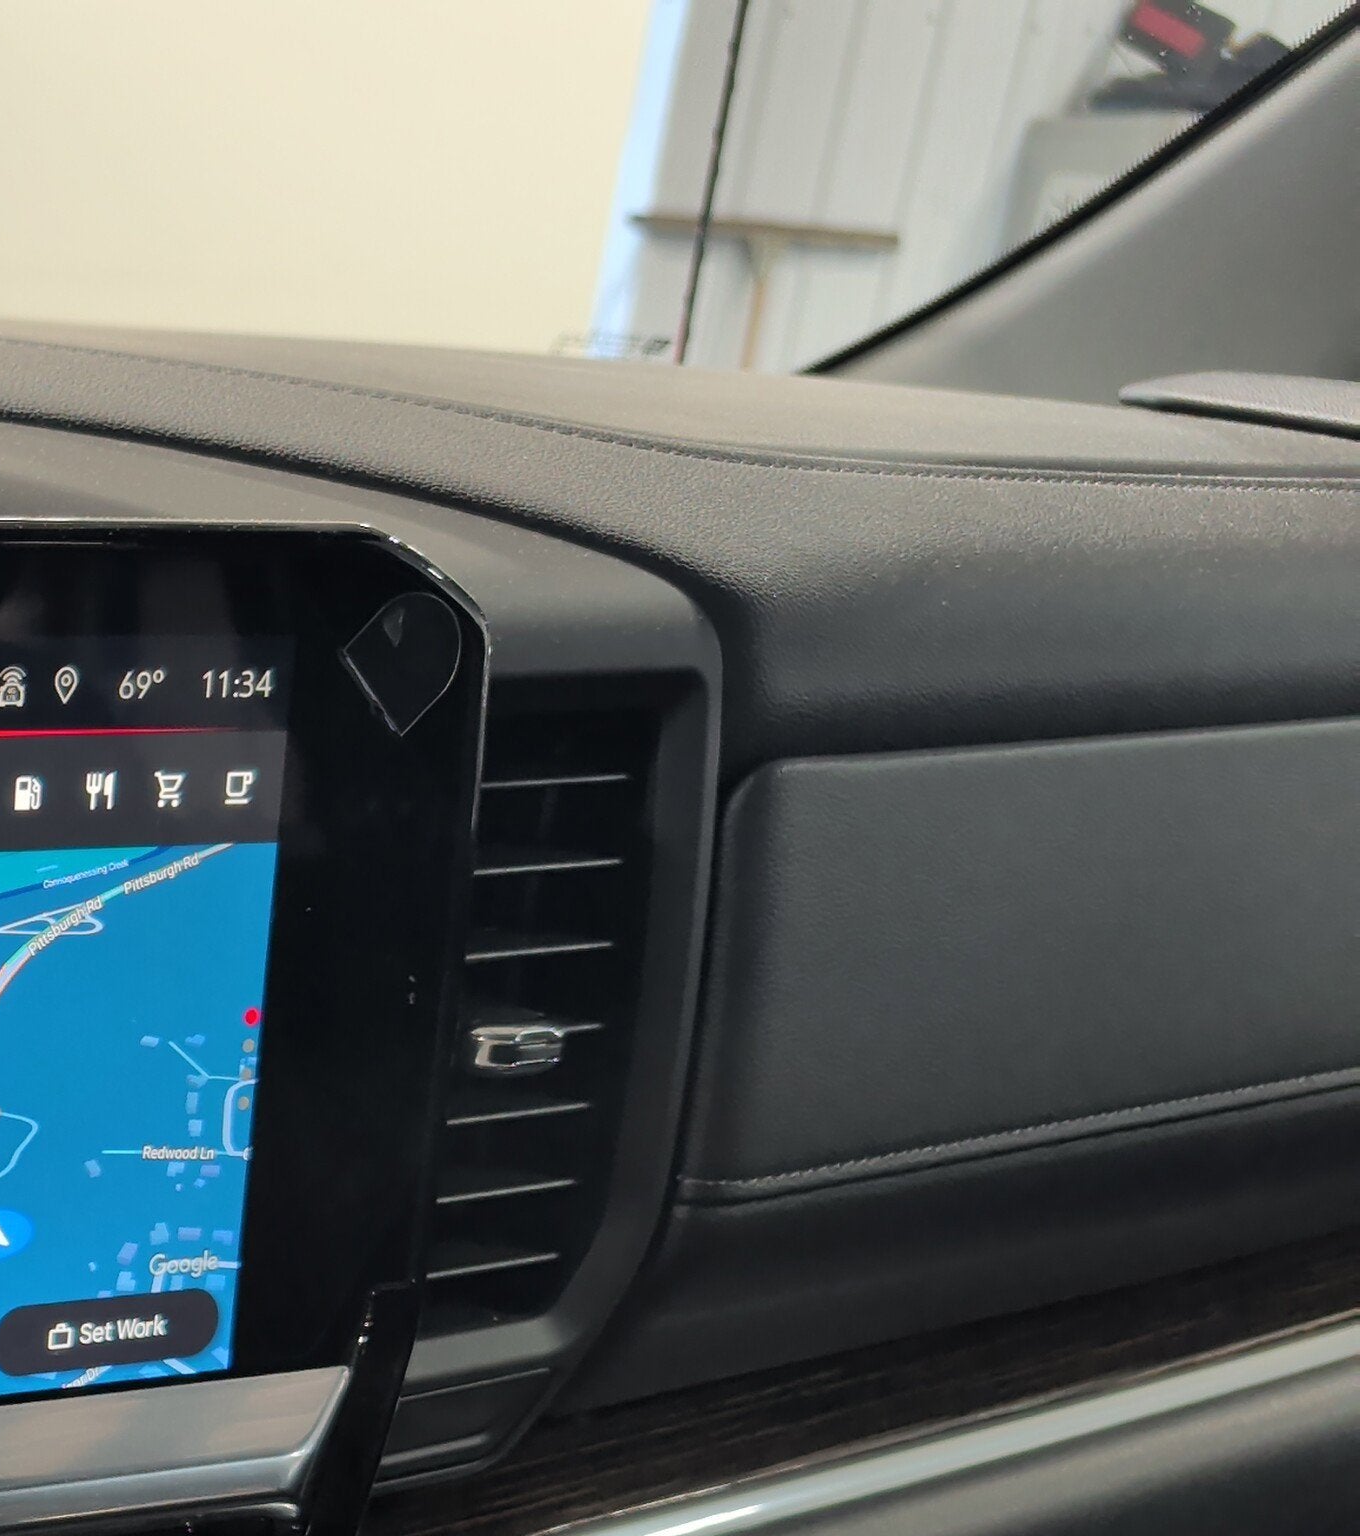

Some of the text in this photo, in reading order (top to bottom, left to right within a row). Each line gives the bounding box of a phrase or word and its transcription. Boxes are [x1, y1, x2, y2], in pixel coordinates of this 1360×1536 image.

[202, 669, 273, 699] 11:34
[124, 852, 200, 895] Pittsburgh Rd
[27, 895, 103, 956] Pittsburgh Rd
[142, 1145, 215, 1160] Redwood Ln
[149, 1250, 219, 1278] Google
[79, 1314, 167, 1345] Set Work
